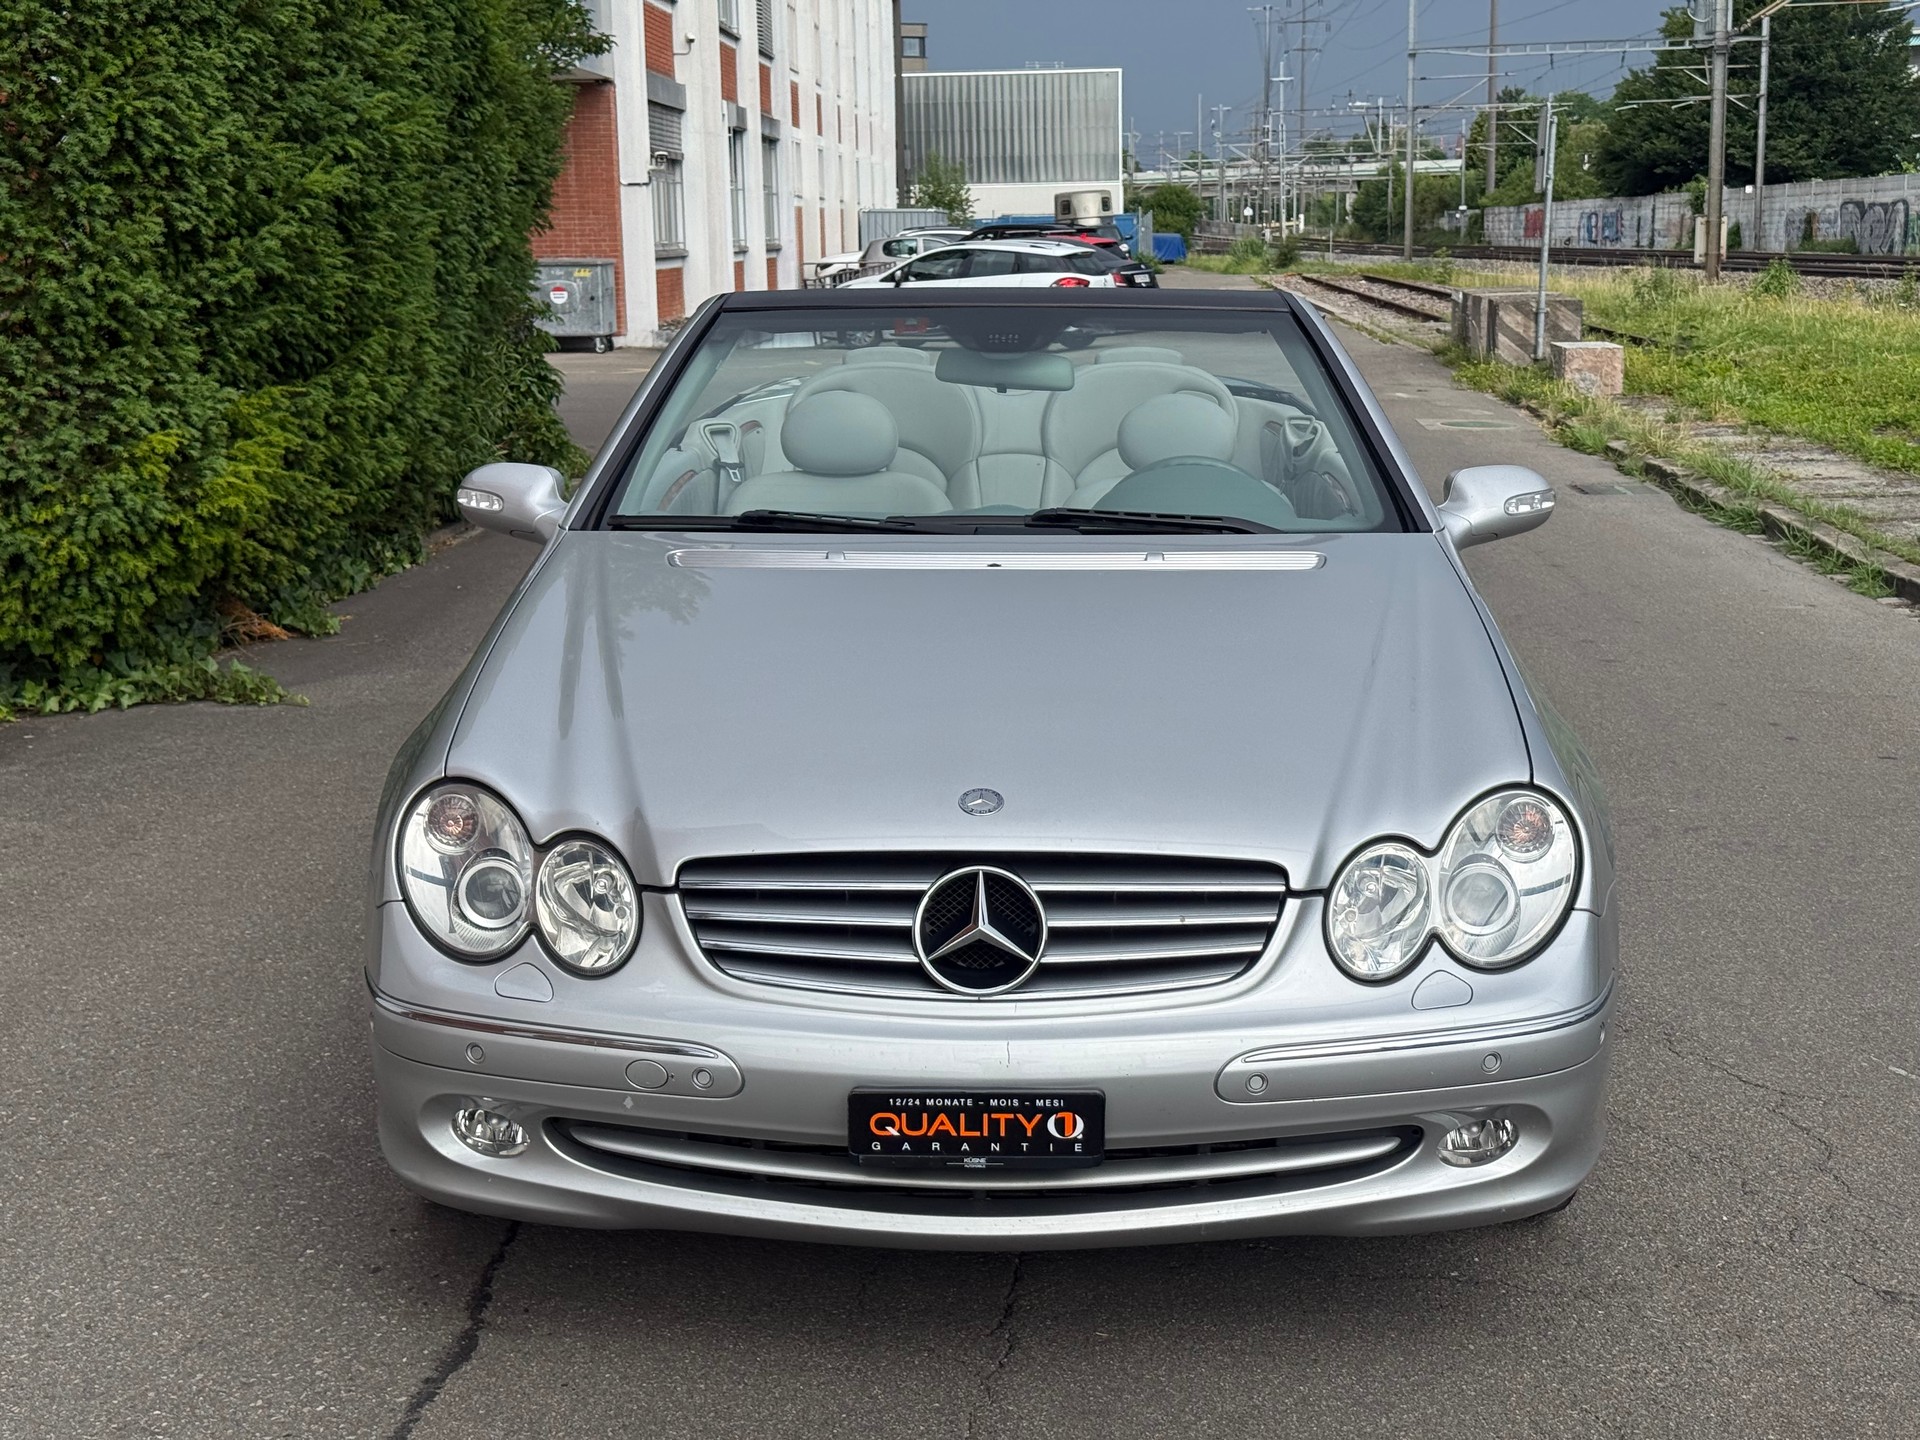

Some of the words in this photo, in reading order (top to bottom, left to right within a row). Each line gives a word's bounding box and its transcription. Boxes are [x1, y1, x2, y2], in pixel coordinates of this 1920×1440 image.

[888, 1098, 920, 1107] 12/24
[926, 1098, 973, 1107] MONATE
[989, 1098, 1019, 1107] MOIS
[1035, 1098, 1064, 1107] MESI
[869, 1112, 1043, 1137] QUALITY
[871, 1141, 1082, 1152] GARANTIE
